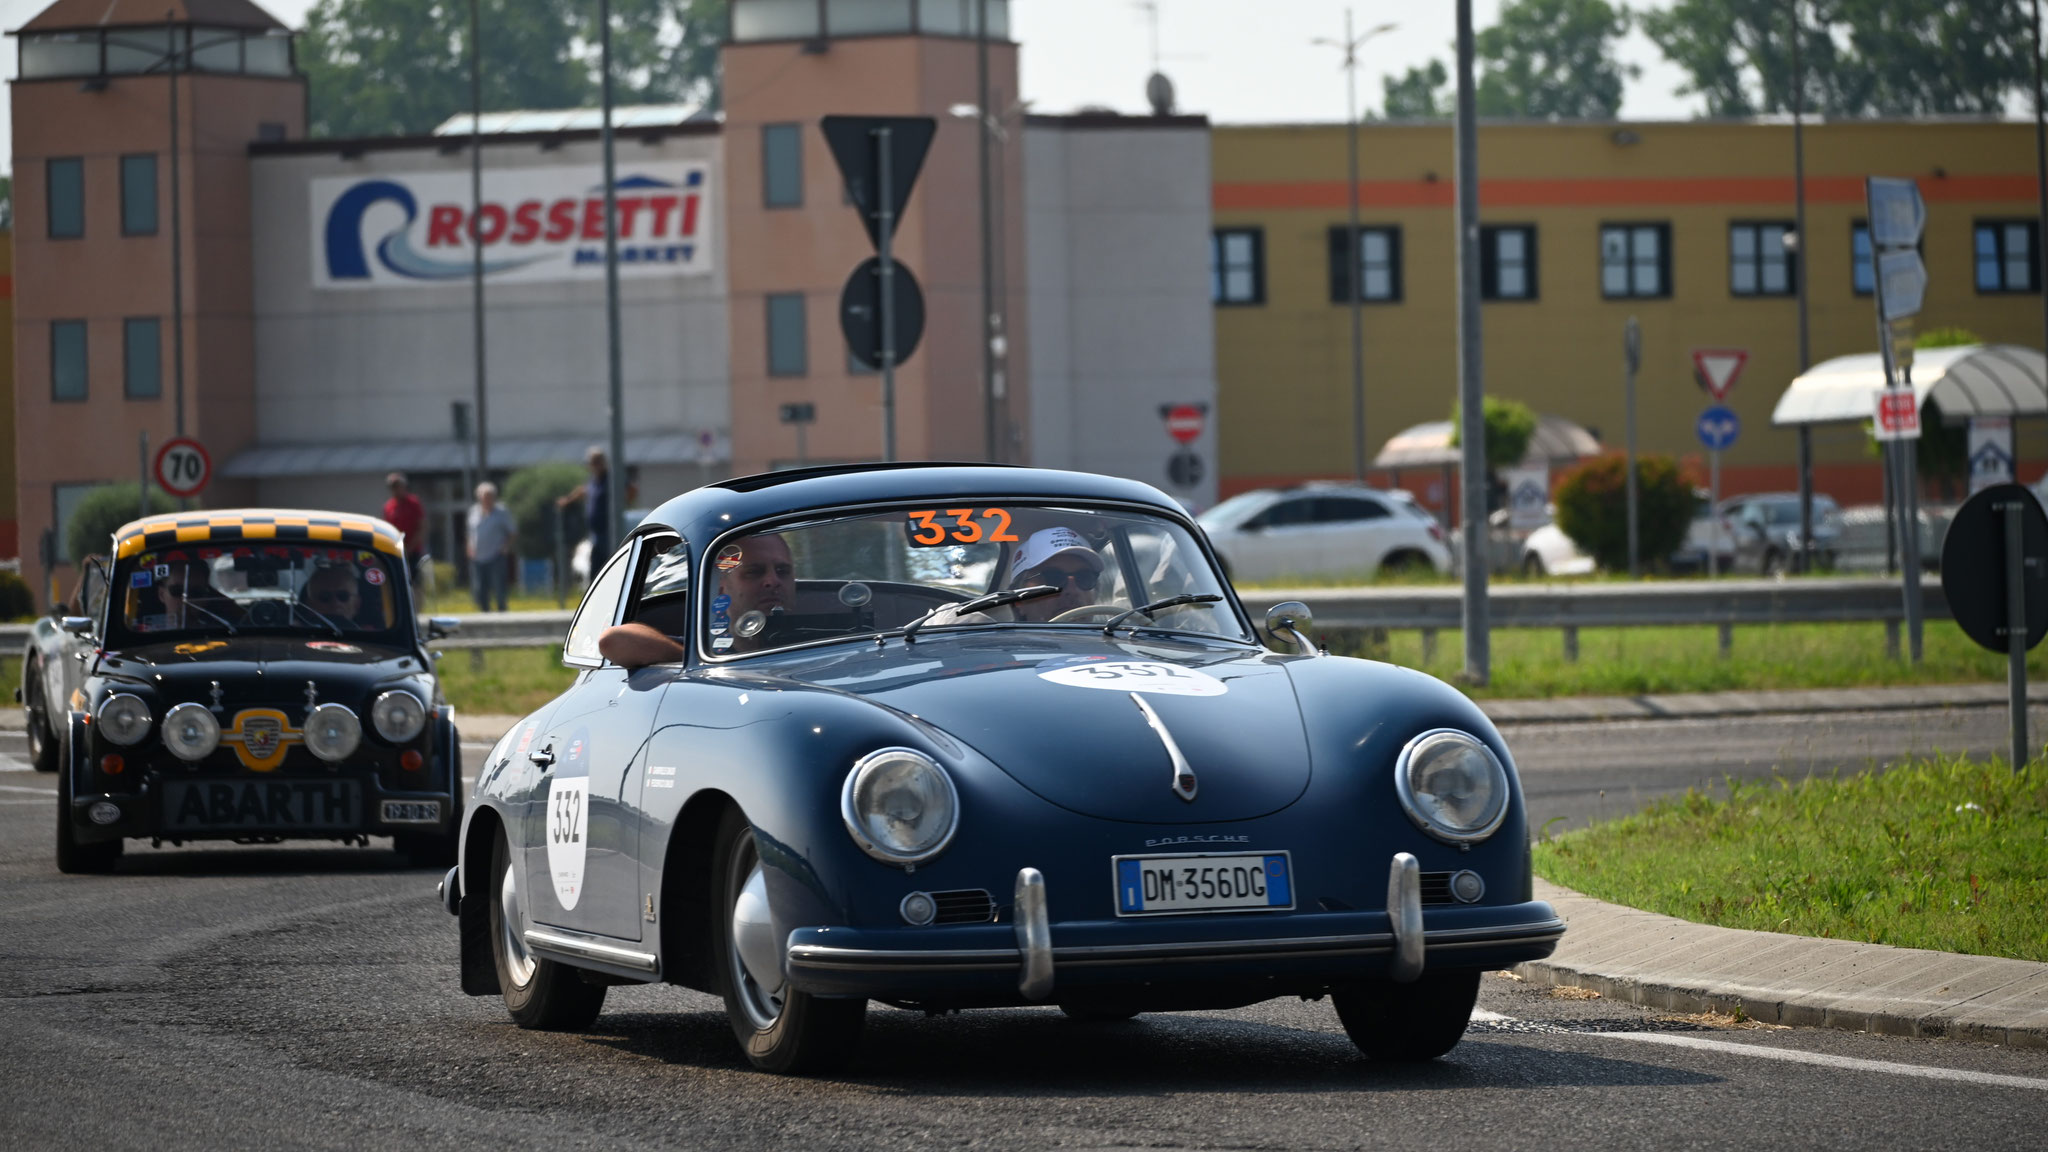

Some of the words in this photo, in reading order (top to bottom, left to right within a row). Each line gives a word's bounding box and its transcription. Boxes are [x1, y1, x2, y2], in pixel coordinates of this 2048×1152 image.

[426, 194, 700, 247] ROSSETTI
[169, 452, 201, 482] 70
[908, 508, 1020, 545] 332
[1071, 663, 1193, 680] 332
[175, 783, 351, 825] ABARTH
[553, 790, 581, 844] 332
[1145, 835, 1250, 847] PORSCHE
